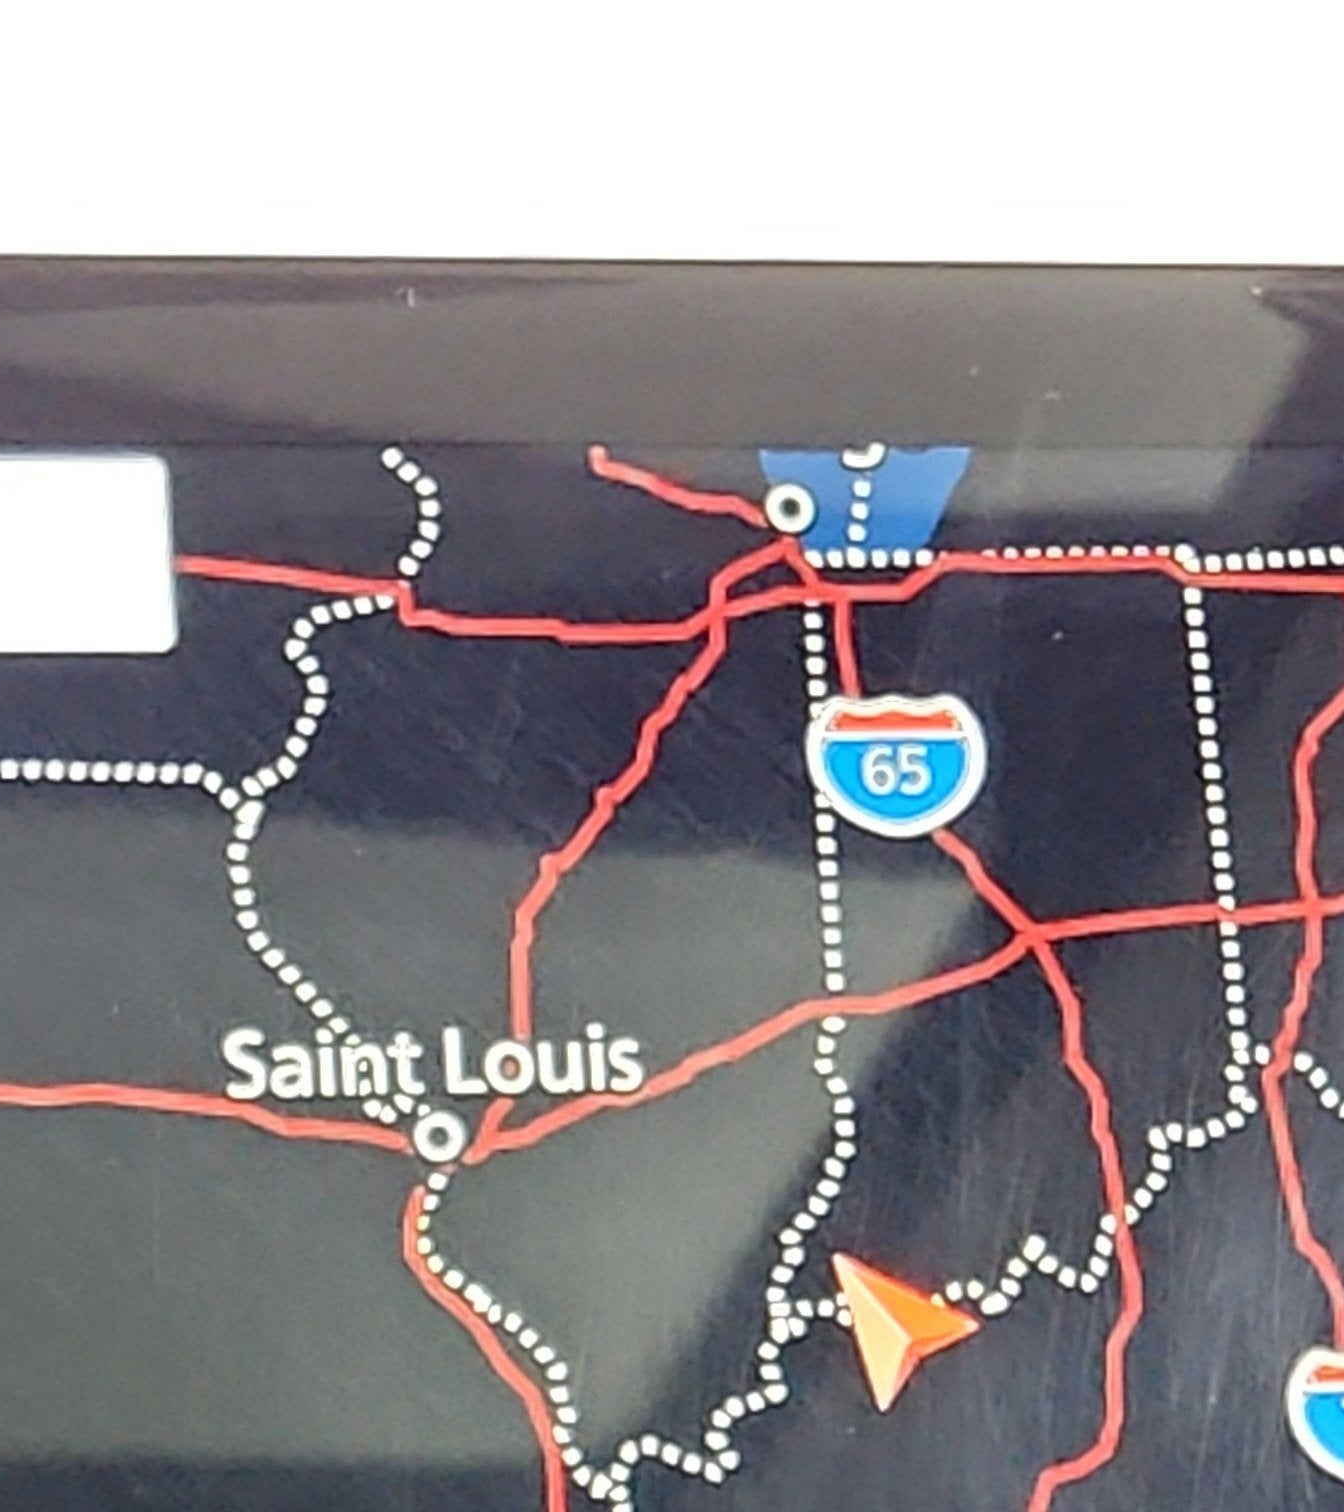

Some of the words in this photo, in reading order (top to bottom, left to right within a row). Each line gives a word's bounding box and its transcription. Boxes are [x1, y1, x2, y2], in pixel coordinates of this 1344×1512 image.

[860, 745, 933, 796] 65
[221, 1027, 425, 1099] Saint
[442, 1022, 644, 1095] Louis
